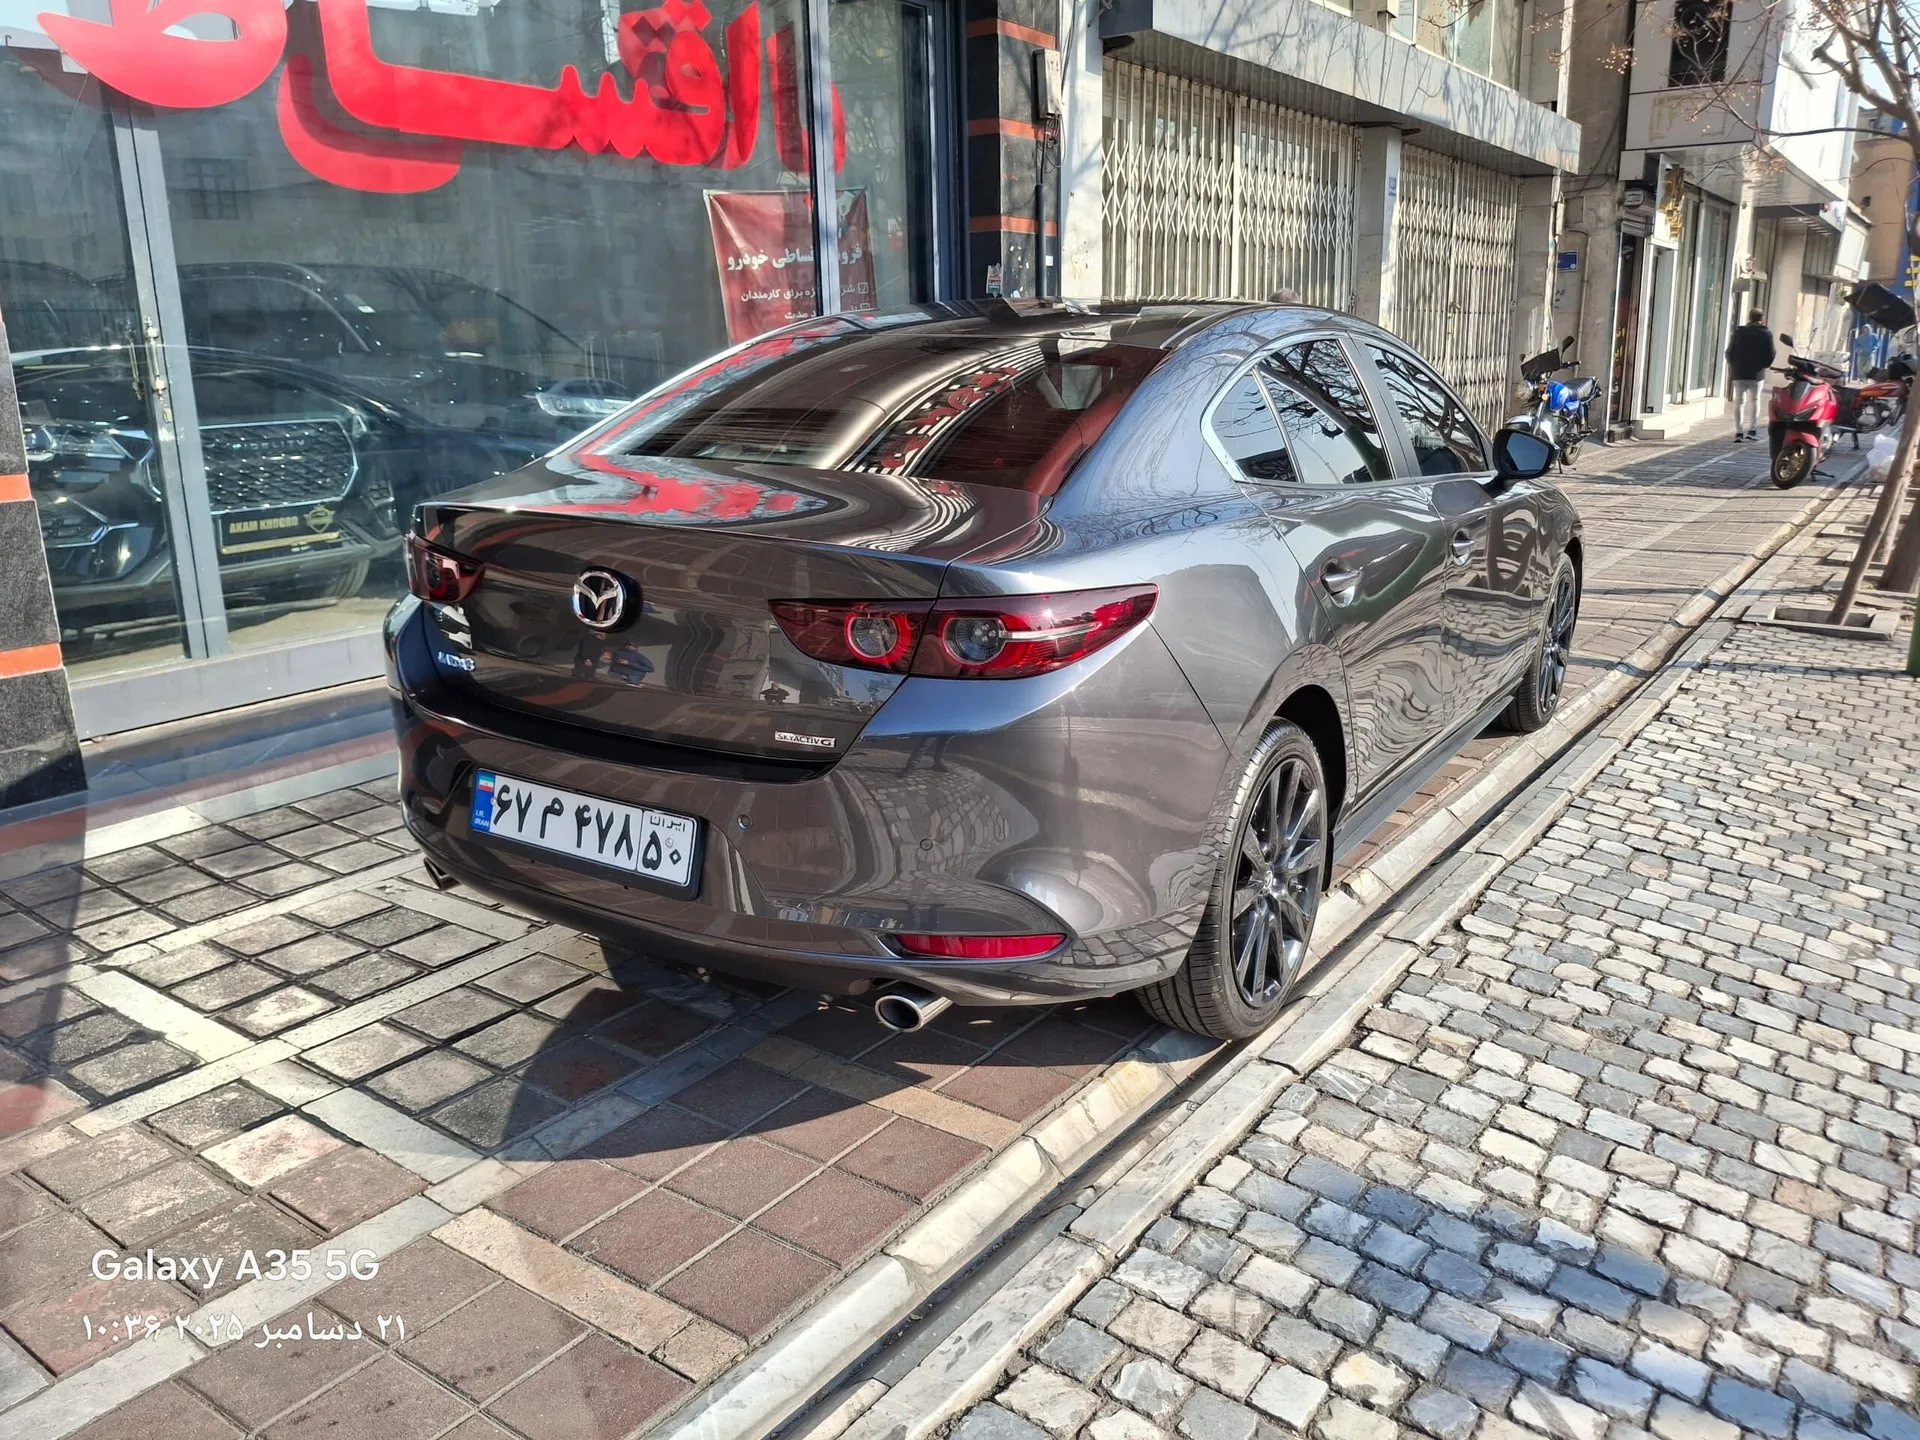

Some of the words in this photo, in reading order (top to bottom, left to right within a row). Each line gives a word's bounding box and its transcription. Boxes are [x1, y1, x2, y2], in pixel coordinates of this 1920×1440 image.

[37, 0, 759, 168] اقساط
[727, 249, 769, 271] خودرو
[772, 245, 814, 269] ساطی
[837, 243, 863, 265] فرو
[740, 288, 781, 302] کارمندان
[783, 288, 803, 299] برای
[229, 520, 259, 534] AKAM
[474, 817, 490, 828] IRAN
[649, 815, 686, 833] ایران
